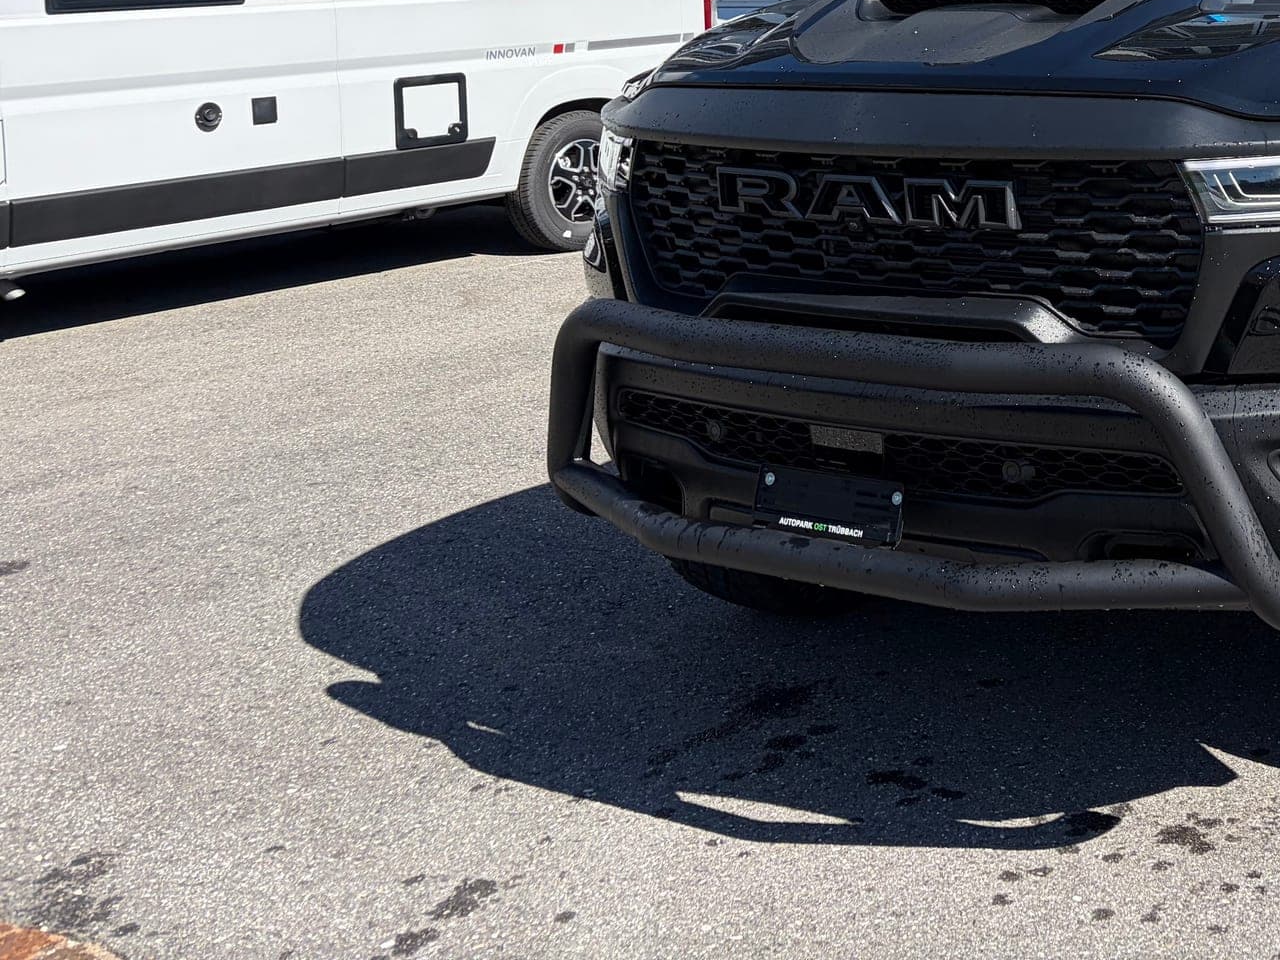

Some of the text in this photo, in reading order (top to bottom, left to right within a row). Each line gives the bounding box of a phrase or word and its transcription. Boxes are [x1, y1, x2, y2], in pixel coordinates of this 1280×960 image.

[486, 47, 536, 60] INNOVAN
[716, 166, 1023, 230] RAM
[779, 517, 814, 530] AUTOPARK
[813, 523, 827, 532] OST
